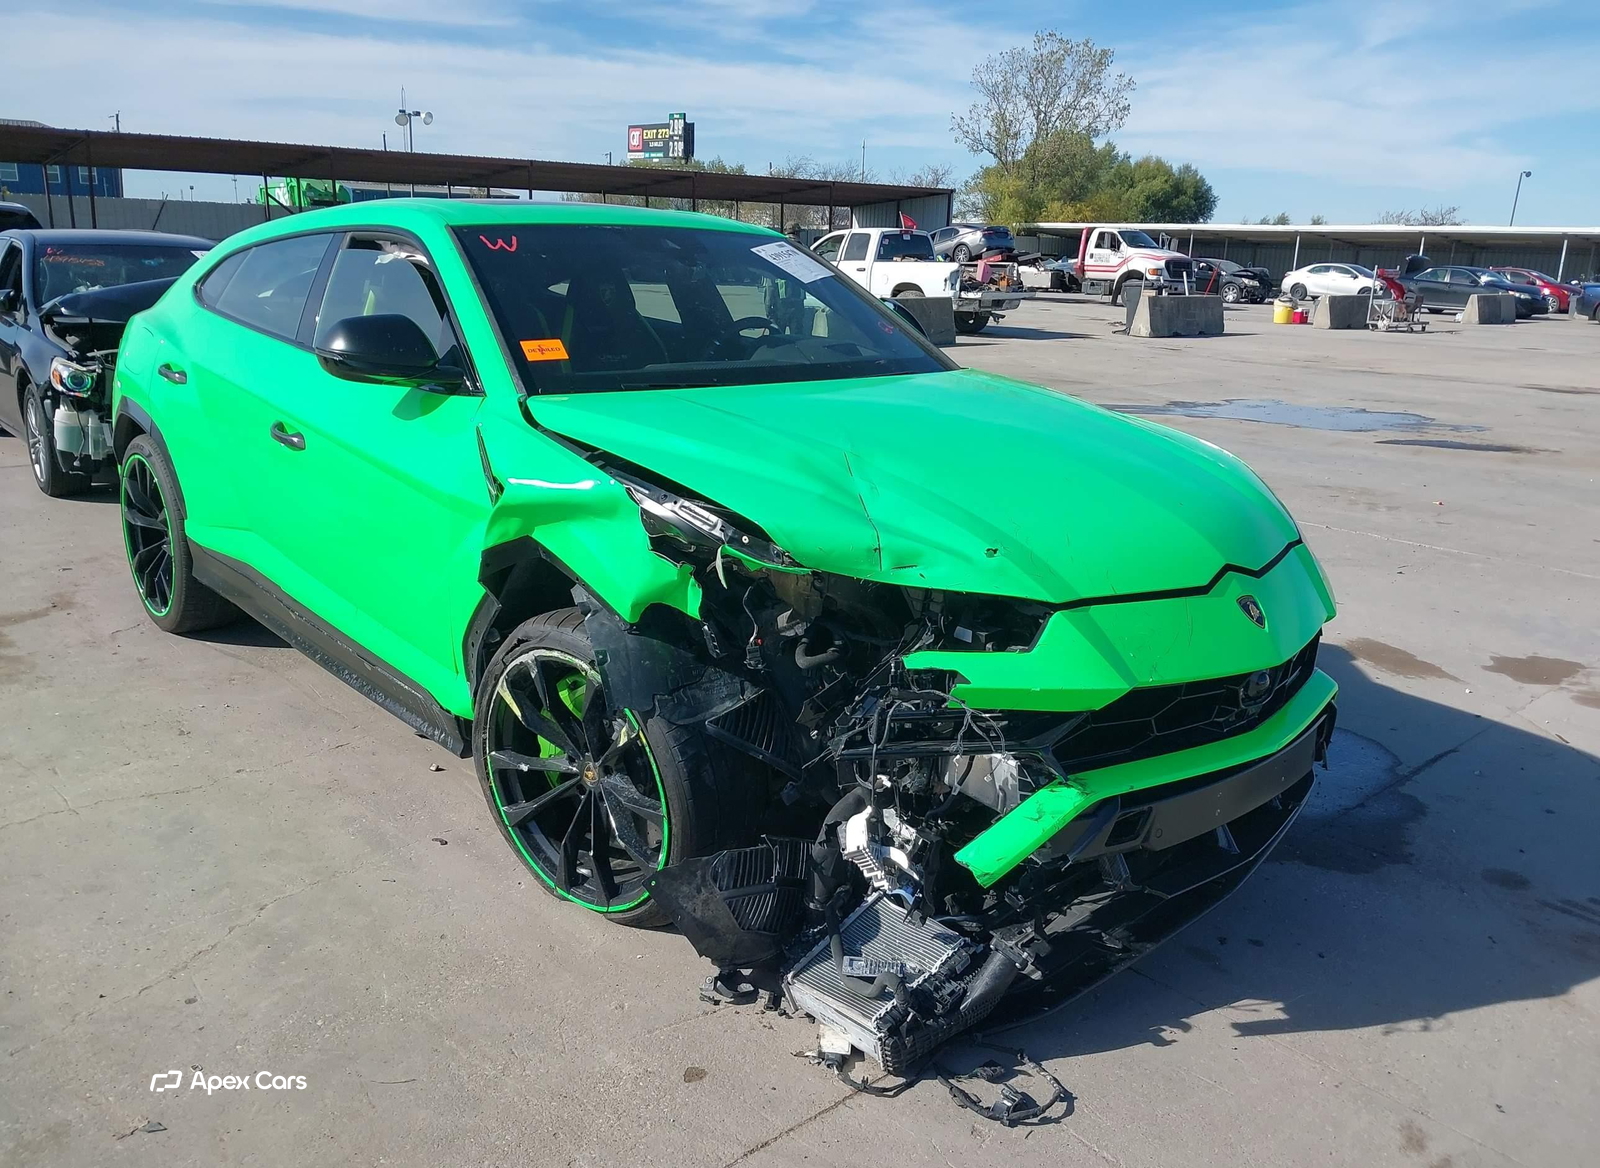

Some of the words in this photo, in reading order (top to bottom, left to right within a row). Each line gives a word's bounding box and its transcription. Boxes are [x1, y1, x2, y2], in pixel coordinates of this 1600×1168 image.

[631, 131, 641, 146] QT
[643, 130, 657, 139] EXIT
[657, 128, 669, 138] 273
[479, 235, 517, 251] W
